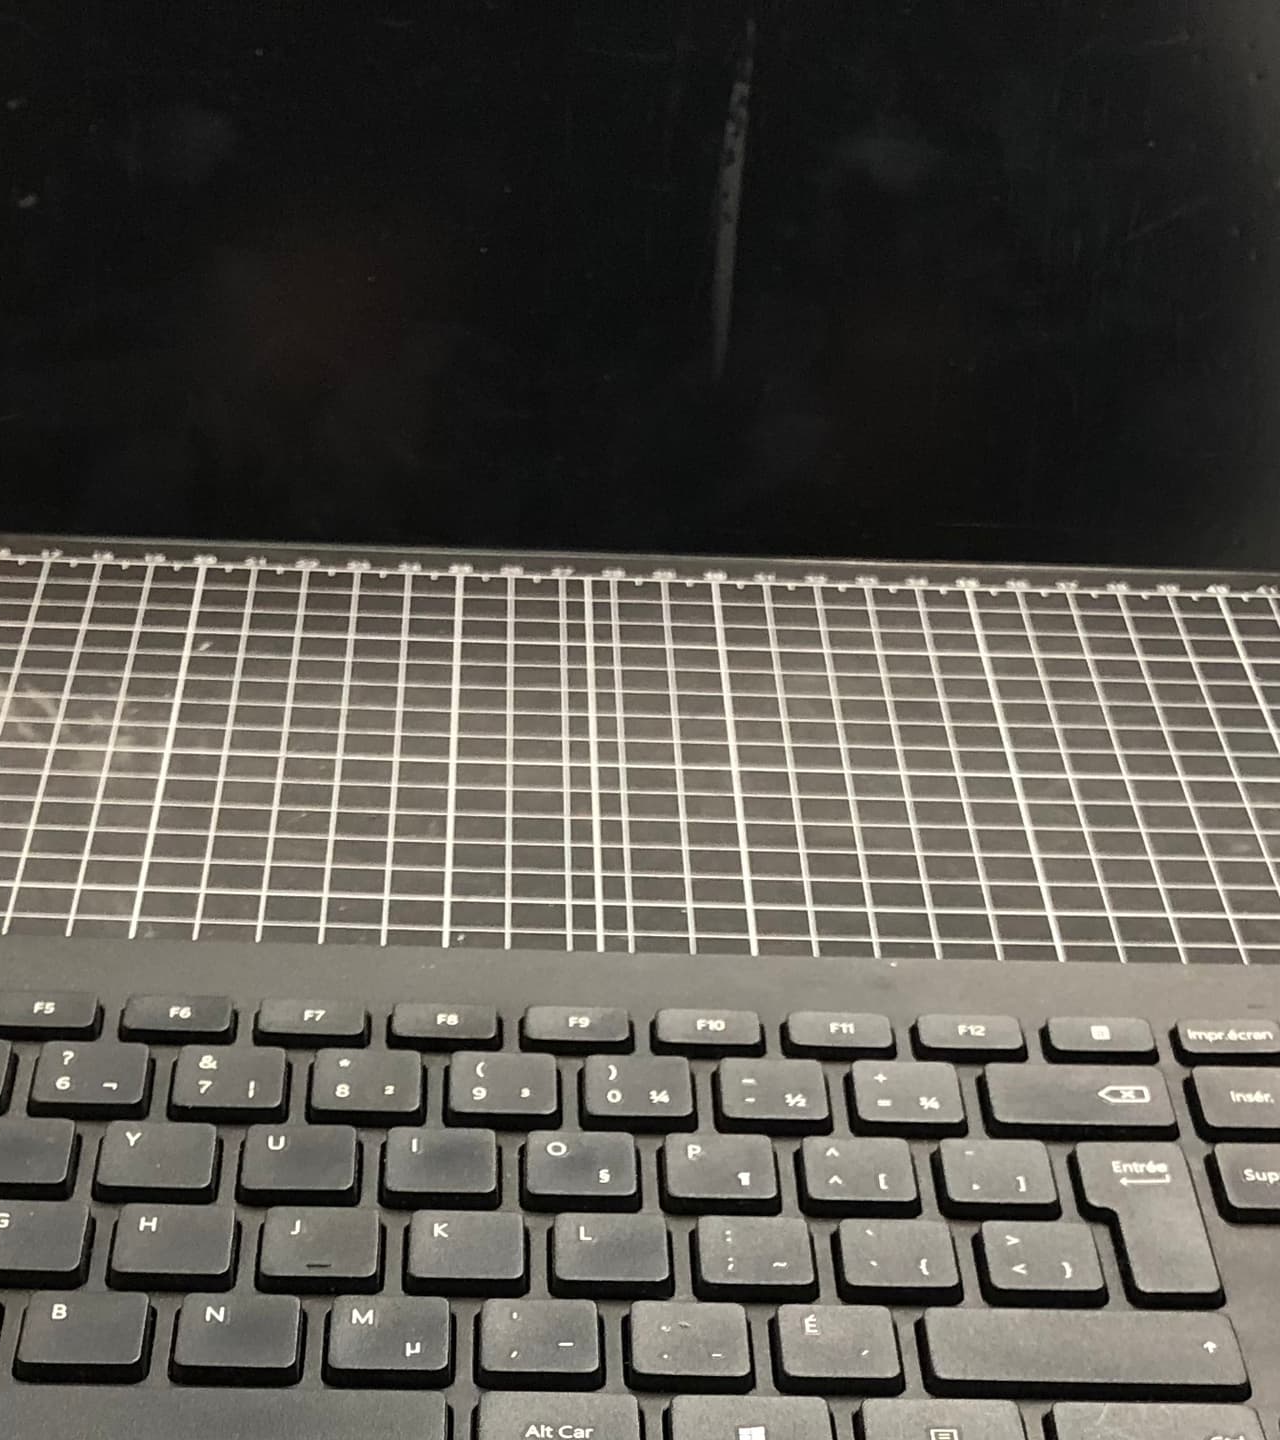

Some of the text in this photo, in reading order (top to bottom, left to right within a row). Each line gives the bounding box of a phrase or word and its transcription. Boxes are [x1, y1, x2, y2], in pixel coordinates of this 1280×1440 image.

[33, 1001, 55, 1014] F5
[169, 1006, 191, 1019] F6
[304, 1009, 326, 1021] F7
[437, 1013, 458, 1025] F8
[569, 1016, 590, 1028] F9
[697, 1019, 725, 1031] F10
[829, 1022, 854, 1034] F11
[958, 1024, 986, 1036] F12
[63, 1050, 74, 1065] ?
[199, 1055, 217, 1069] &
[56, 1076, 70, 1090] 6
[198, 1080, 212, 1094] 7
[335, 1084, 350, 1097] 8
[472, 1087, 487, 1100] 9
[607, 1090, 622, 1103] 0
[1230, 1090, 1274, 1103] Insér.
[126, 1131, 142, 1146] Y
[268, 1135, 285, 1150] U
[412, 1138, 417, 1152] I
[547, 1141, 567, 1156] O
[687, 1144, 701, 1160] P
[1112, 1160, 1169, 1175] Entrée
[139, 1216, 157, 1232] H
[290, 1220, 301, 1235] J
[434, 1223, 448, 1238] K
[580, 1226, 592, 1241] L
[52, 1304, 67, 1319] B
[205, 1306, 225, 1322] N
[352, 1308, 374, 1325] M
[804, 1314, 820, 1335] É
[525, 1425, 594, 1439] Alt Car
